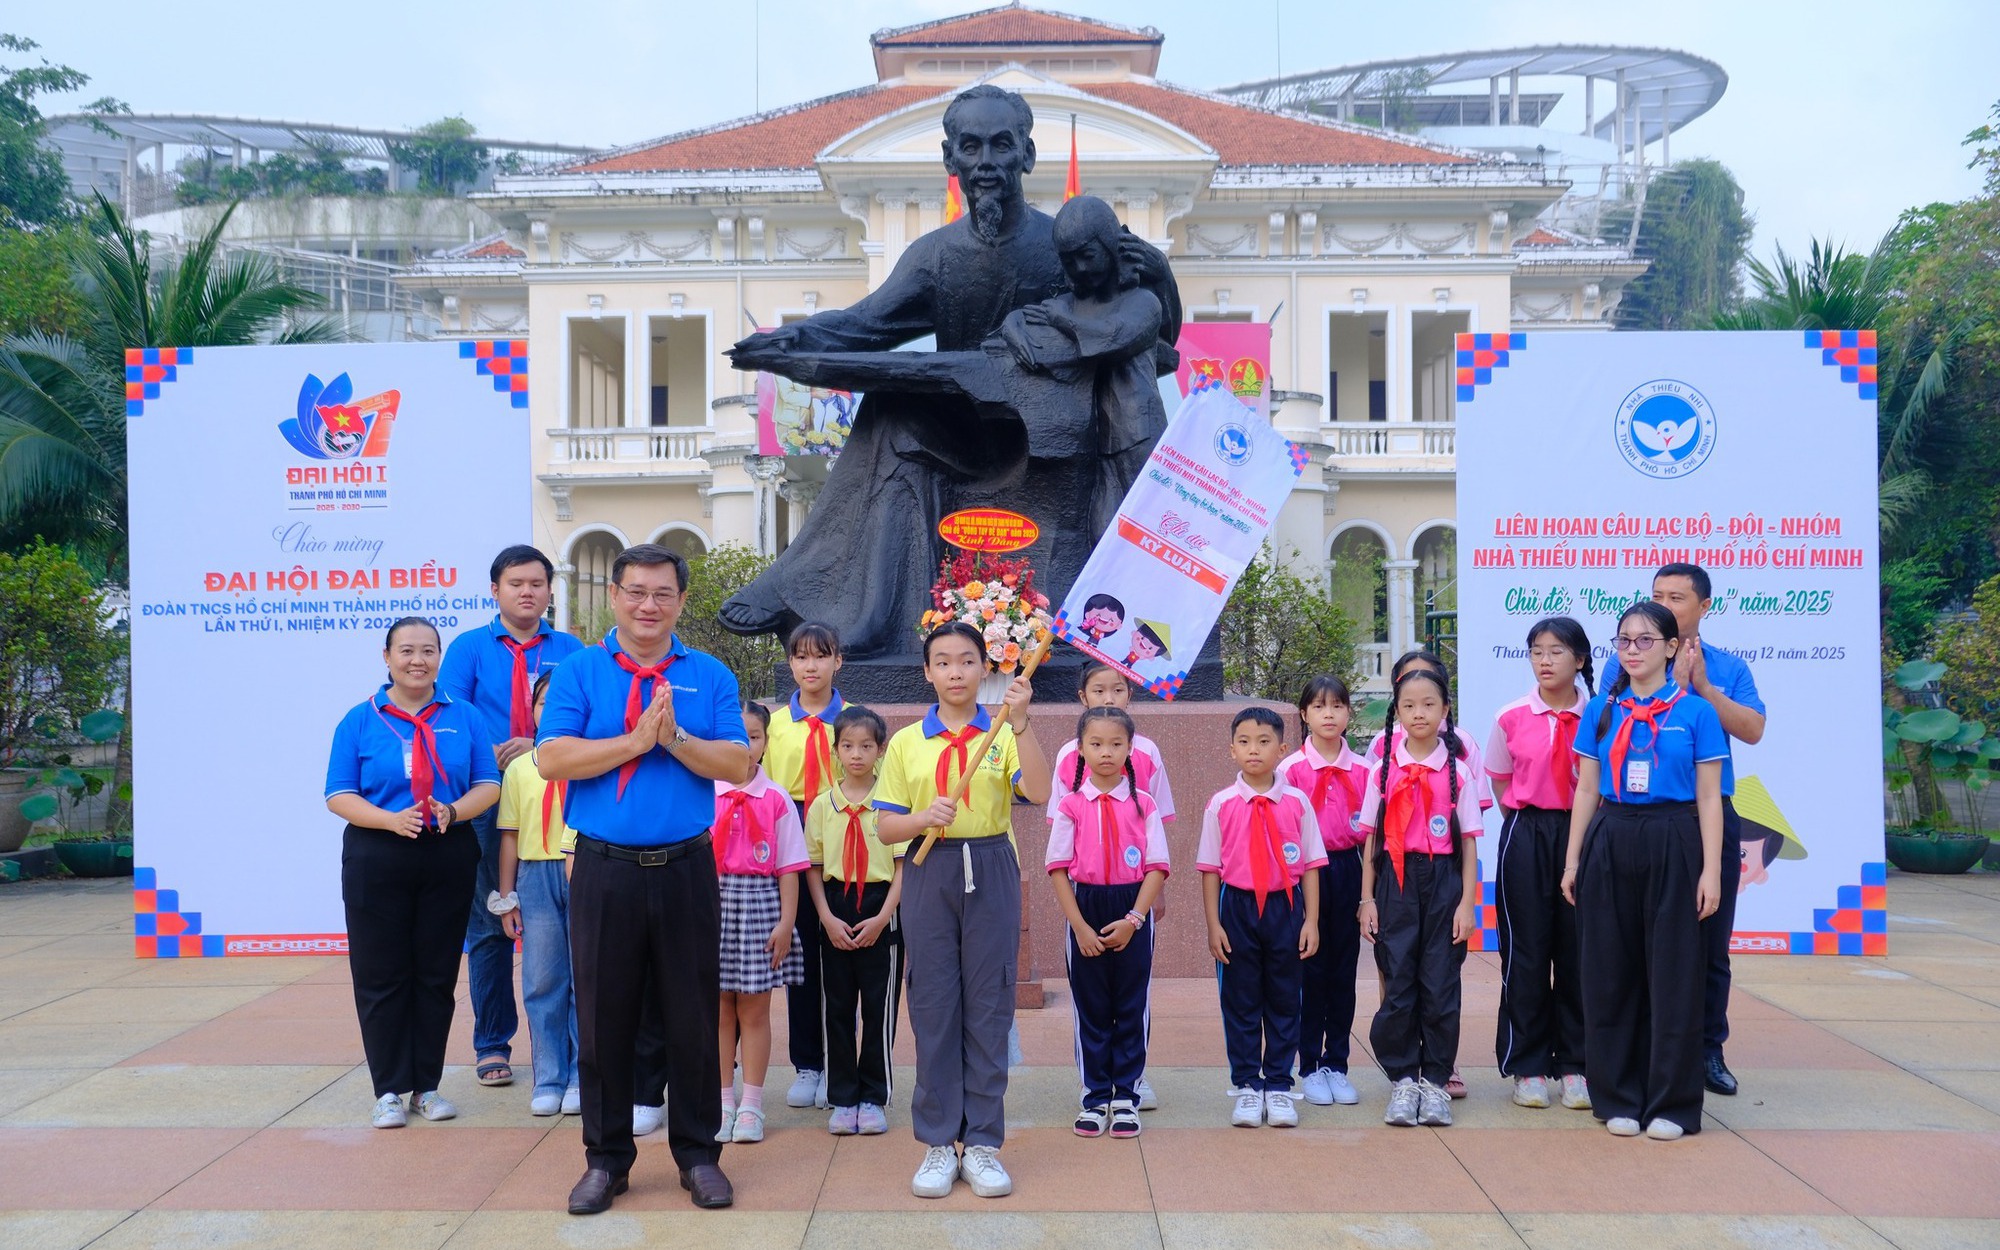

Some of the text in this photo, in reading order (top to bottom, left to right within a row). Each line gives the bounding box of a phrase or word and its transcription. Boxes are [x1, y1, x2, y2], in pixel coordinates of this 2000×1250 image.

[1688, 393, 1704, 409] NHI
[1697, 434, 1711, 456] MINH
[286, 461, 387, 488] ĐẠI HỘI I
[364, 490, 387, 498] MINH
[341, 503, 360, 511] 2030
[1495, 512, 1538, 536] LIÊN
[1542, 517, 1598, 536] HOAN
[1602, 512, 1640, 536] CÂU
[1645, 517, 1682, 540] LẠC
[1685, 512, 1712, 540] BỘ
[1728, 512, 1763, 540] ĐỘI
[1780, 512, 1841, 536] NHÓM
[272, 521, 384, 567] Chào mừng
[1473, 540, 1863, 567] NHÀ THIẾU NHI THÀNH PHỐ HỒ CHÍ MINH
[204, 559, 457, 598] ĐẠI HỘI ĐẠI BIỂU
[142, 601, 186, 616] ĐOÀN
[190, 602, 232, 615] TNCS
[235, 597, 257, 614] HỒ
[261, 598, 287, 614] CHÍ
[291, 601, 329, 613] MINH
[333, 597, 387, 613] THÀNH
[390, 594, 422, 611] PHỐ
[426, 593, 448, 611] HỒ
[452, 595, 478, 610] CHÍ
[1505, 586, 1540, 612] Chủ
[1739, 591, 1781, 613] năm
[1784, 589, 1832, 613] 2025
[205, 615, 236, 632] LẦN
[239, 616, 272, 632] THỨ
[287, 616, 335, 634] NHIỆM
[339, 615, 360, 630] KỲ
[1492, 645, 1530, 659] Thàn
[1761, 646, 1774, 659] 12
[1777, 648, 1808, 660] năm
[1811, 646, 1846, 660] 2025
